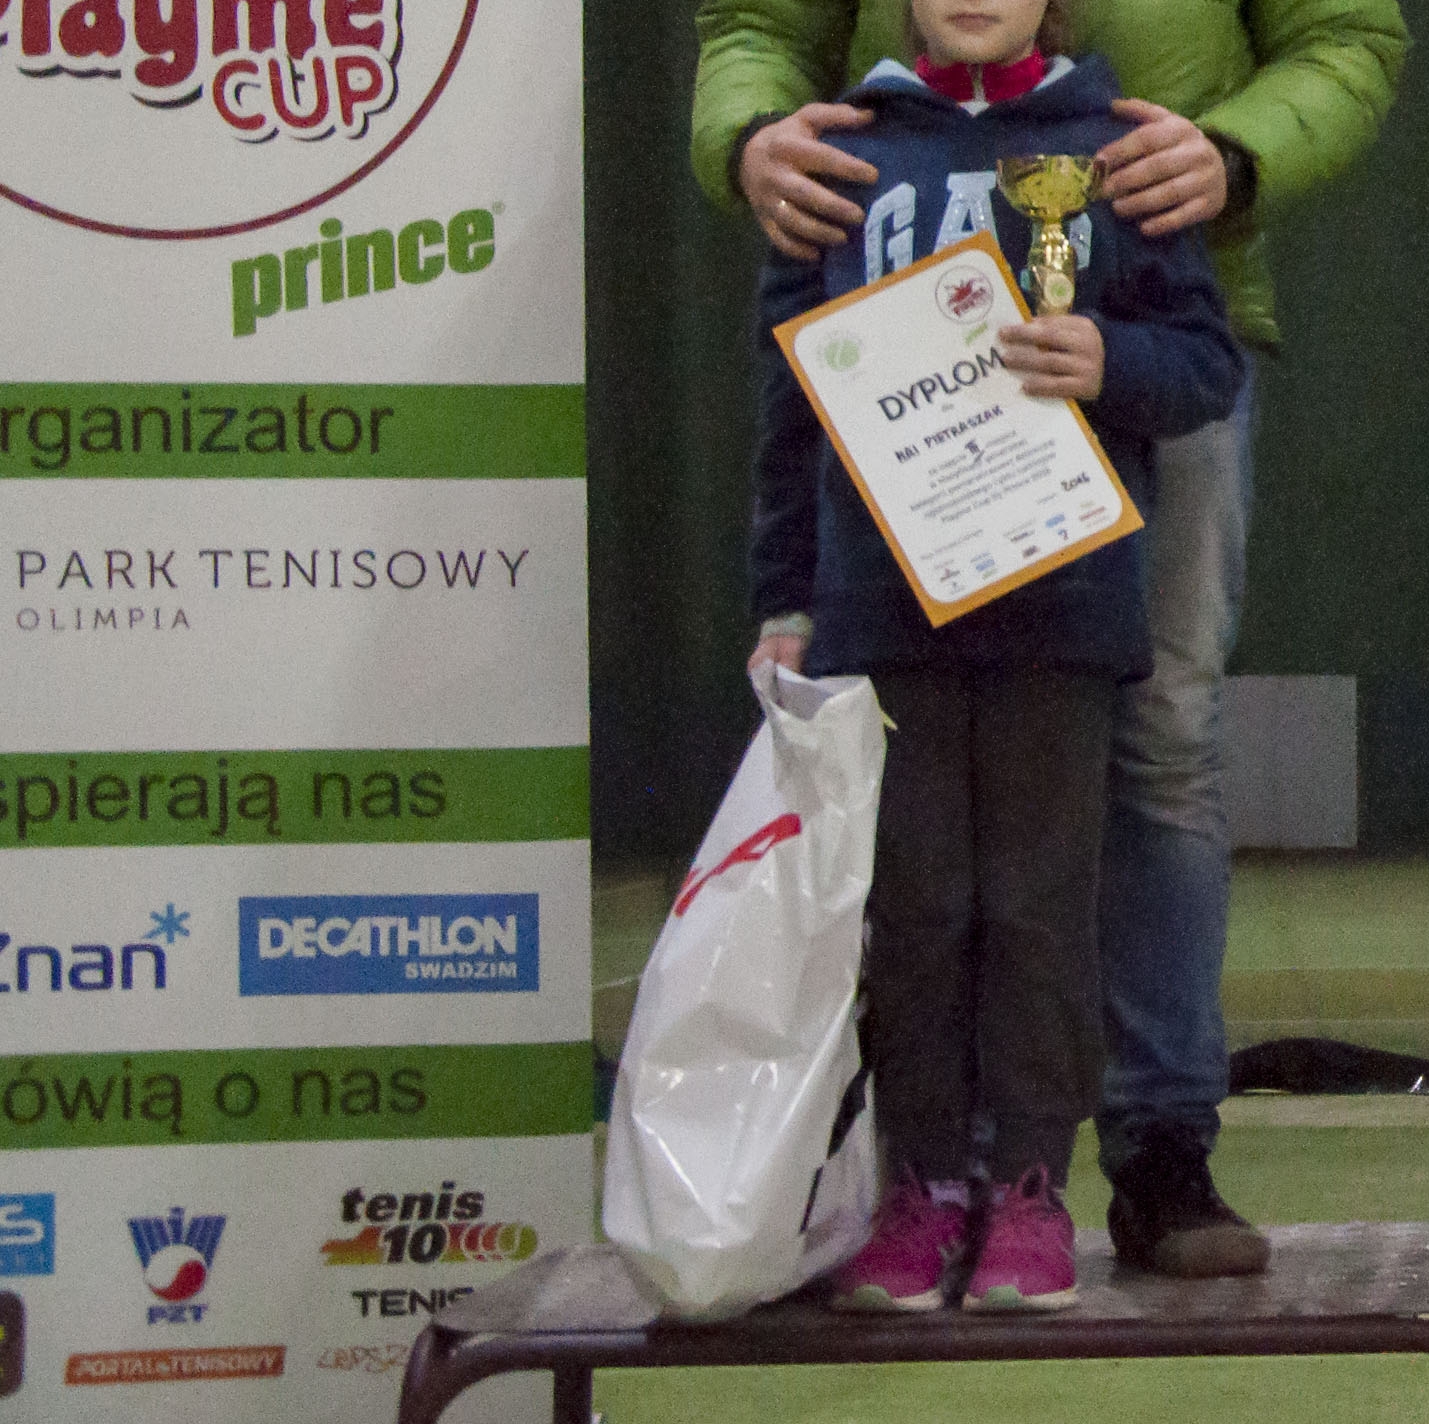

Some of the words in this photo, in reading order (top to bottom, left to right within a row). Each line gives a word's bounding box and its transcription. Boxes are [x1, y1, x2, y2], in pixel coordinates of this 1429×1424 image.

[213, 56, 388, 131] CUP
[232, 208, 497, 338] prince
[877, 346, 1007, 423] DYPLOM
[17, 550, 178, 590] PARK
[199, 549, 530, 590] TENISOWY
[16, 607, 191, 631] OLIMPIA
[0, 759, 281, 840] pierają
[312, 768, 447, 820] nas
[258, 915, 518, 959] DECATHLON
[405, 961, 518, 980] SWADZIM
[214, 1071, 260, 1119] o
[292, 1065, 428, 1116] nas
[342, 1181, 485, 1223] tenis
[384, 1224, 447, 1263] 10
[147, 1303, 208, 1325] PZT
